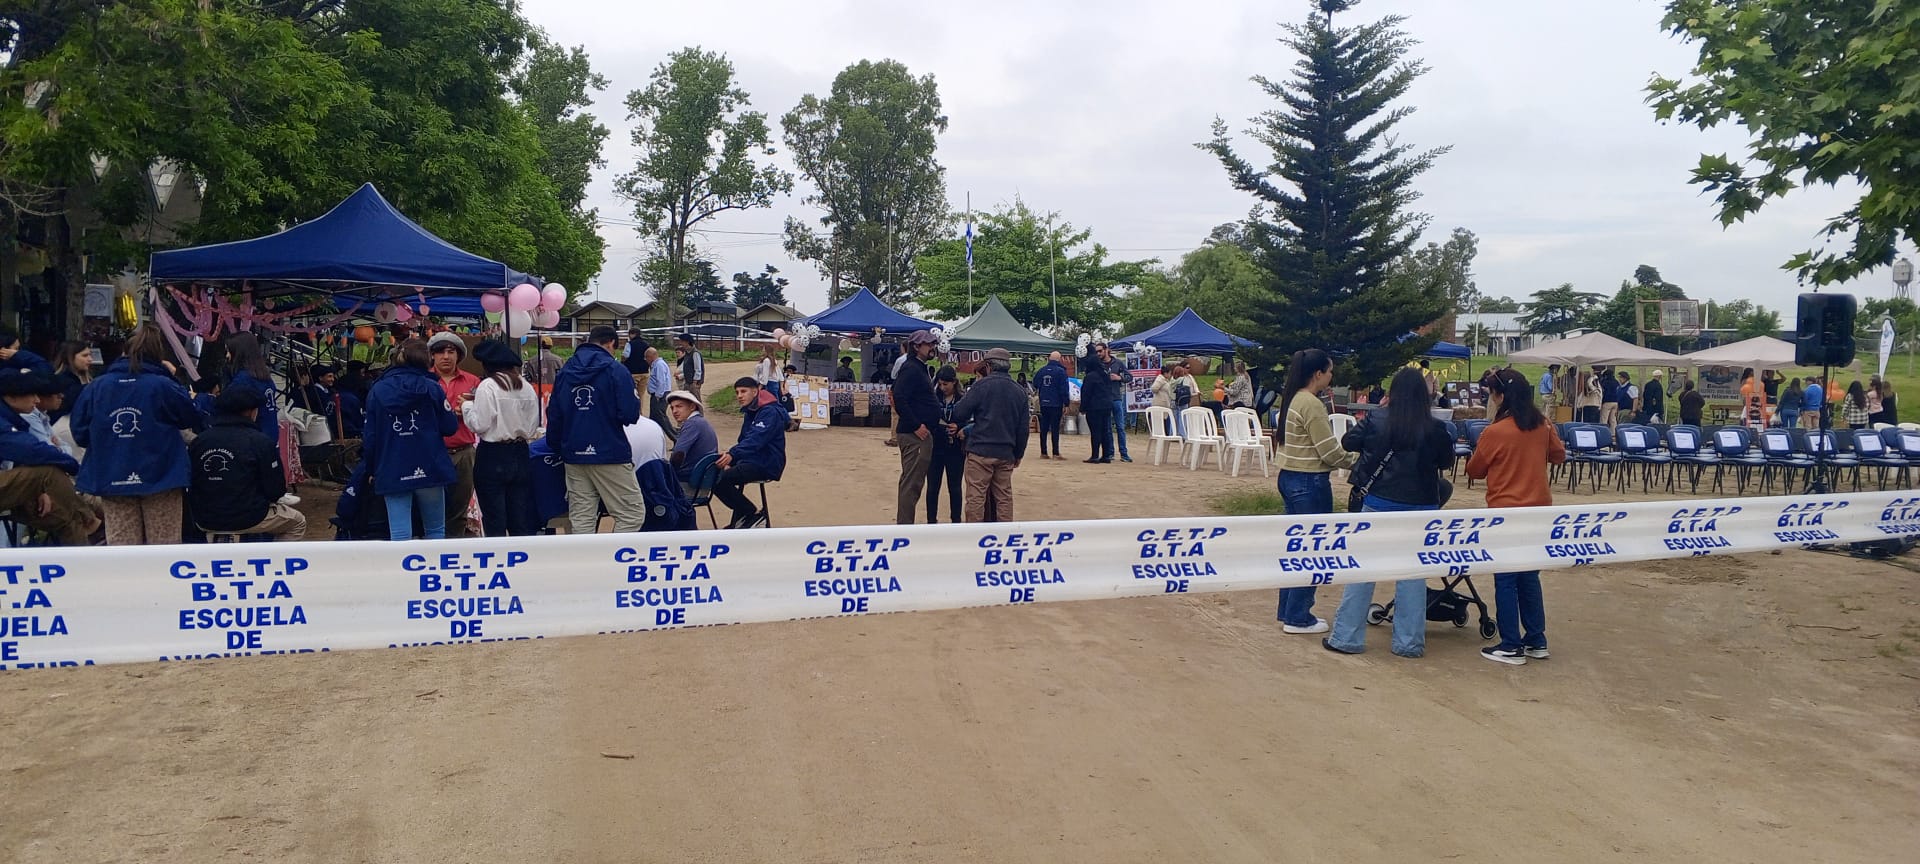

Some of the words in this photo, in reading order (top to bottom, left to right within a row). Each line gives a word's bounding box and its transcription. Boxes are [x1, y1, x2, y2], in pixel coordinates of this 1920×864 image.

[1425, 517, 1504, 531] C.E.T.P
[1668, 519, 1716, 533] B.T.A
[1778, 513, 1823, 527] B.T.A
[1137, 527, 1227, 543] C.E.T.P
[1286, 522, 1371, 537] C.E.T.P
[1551, 524, 1602, 539] B.T.A
[1774, 529, 1839, 542] ESCUELA
[806, 538, 910, 555] C.E.T.P
[978, 532, 1074, 548] C.E.T.P
[1287, 536, 1346, 552] B.T.A
[1424, 531, 1479, 546] B.T.A
[1663, 536, 1731, 550] ESCUELA
[615, 544, 730, 563] C.E.T.P
[984, 548, 1052, 565] B.T.A
[1140, 541, 1204, 558] B.T.A
[1417, 549, 1493, 565] ESCUELA
[1545, 542, 1616, 557] ESCUELA
[170, 558, 308, 578] C.E.T.P
[402, 551, 528, 571] C.E.T.P
[815, 555, 889, 573] B.T.A
[1279, 556, 1360, 572] ESCUELA
[628, 563, 710, 583] B.T.A
[976, 569, 1065, 586] ESCUELA
[1133, 562, 1217, 579] ESCUELA
[1312, 572, 1334, 584] DE
[1448, 565, 1470, 576] DE
[420, 572, 510, 592] B.T.A
[805, 577, 902, 596] ESCUELA
[1166, 580, 1189, 592] DE
[192, 580, 292, 601] B.T.A
[616, 586, 723, 608] ESCUELA
[1010, 587, 1035, 602] DE
[408, 596, 524, 619] ESCUELA
[841, 597, 869, 613] DE
[179, 606, 307, 630] ESCUELA
[656, 608, 685, 625] DE
[451, 619, 483, 638] DE
[227, 630, 262, 649] DE
